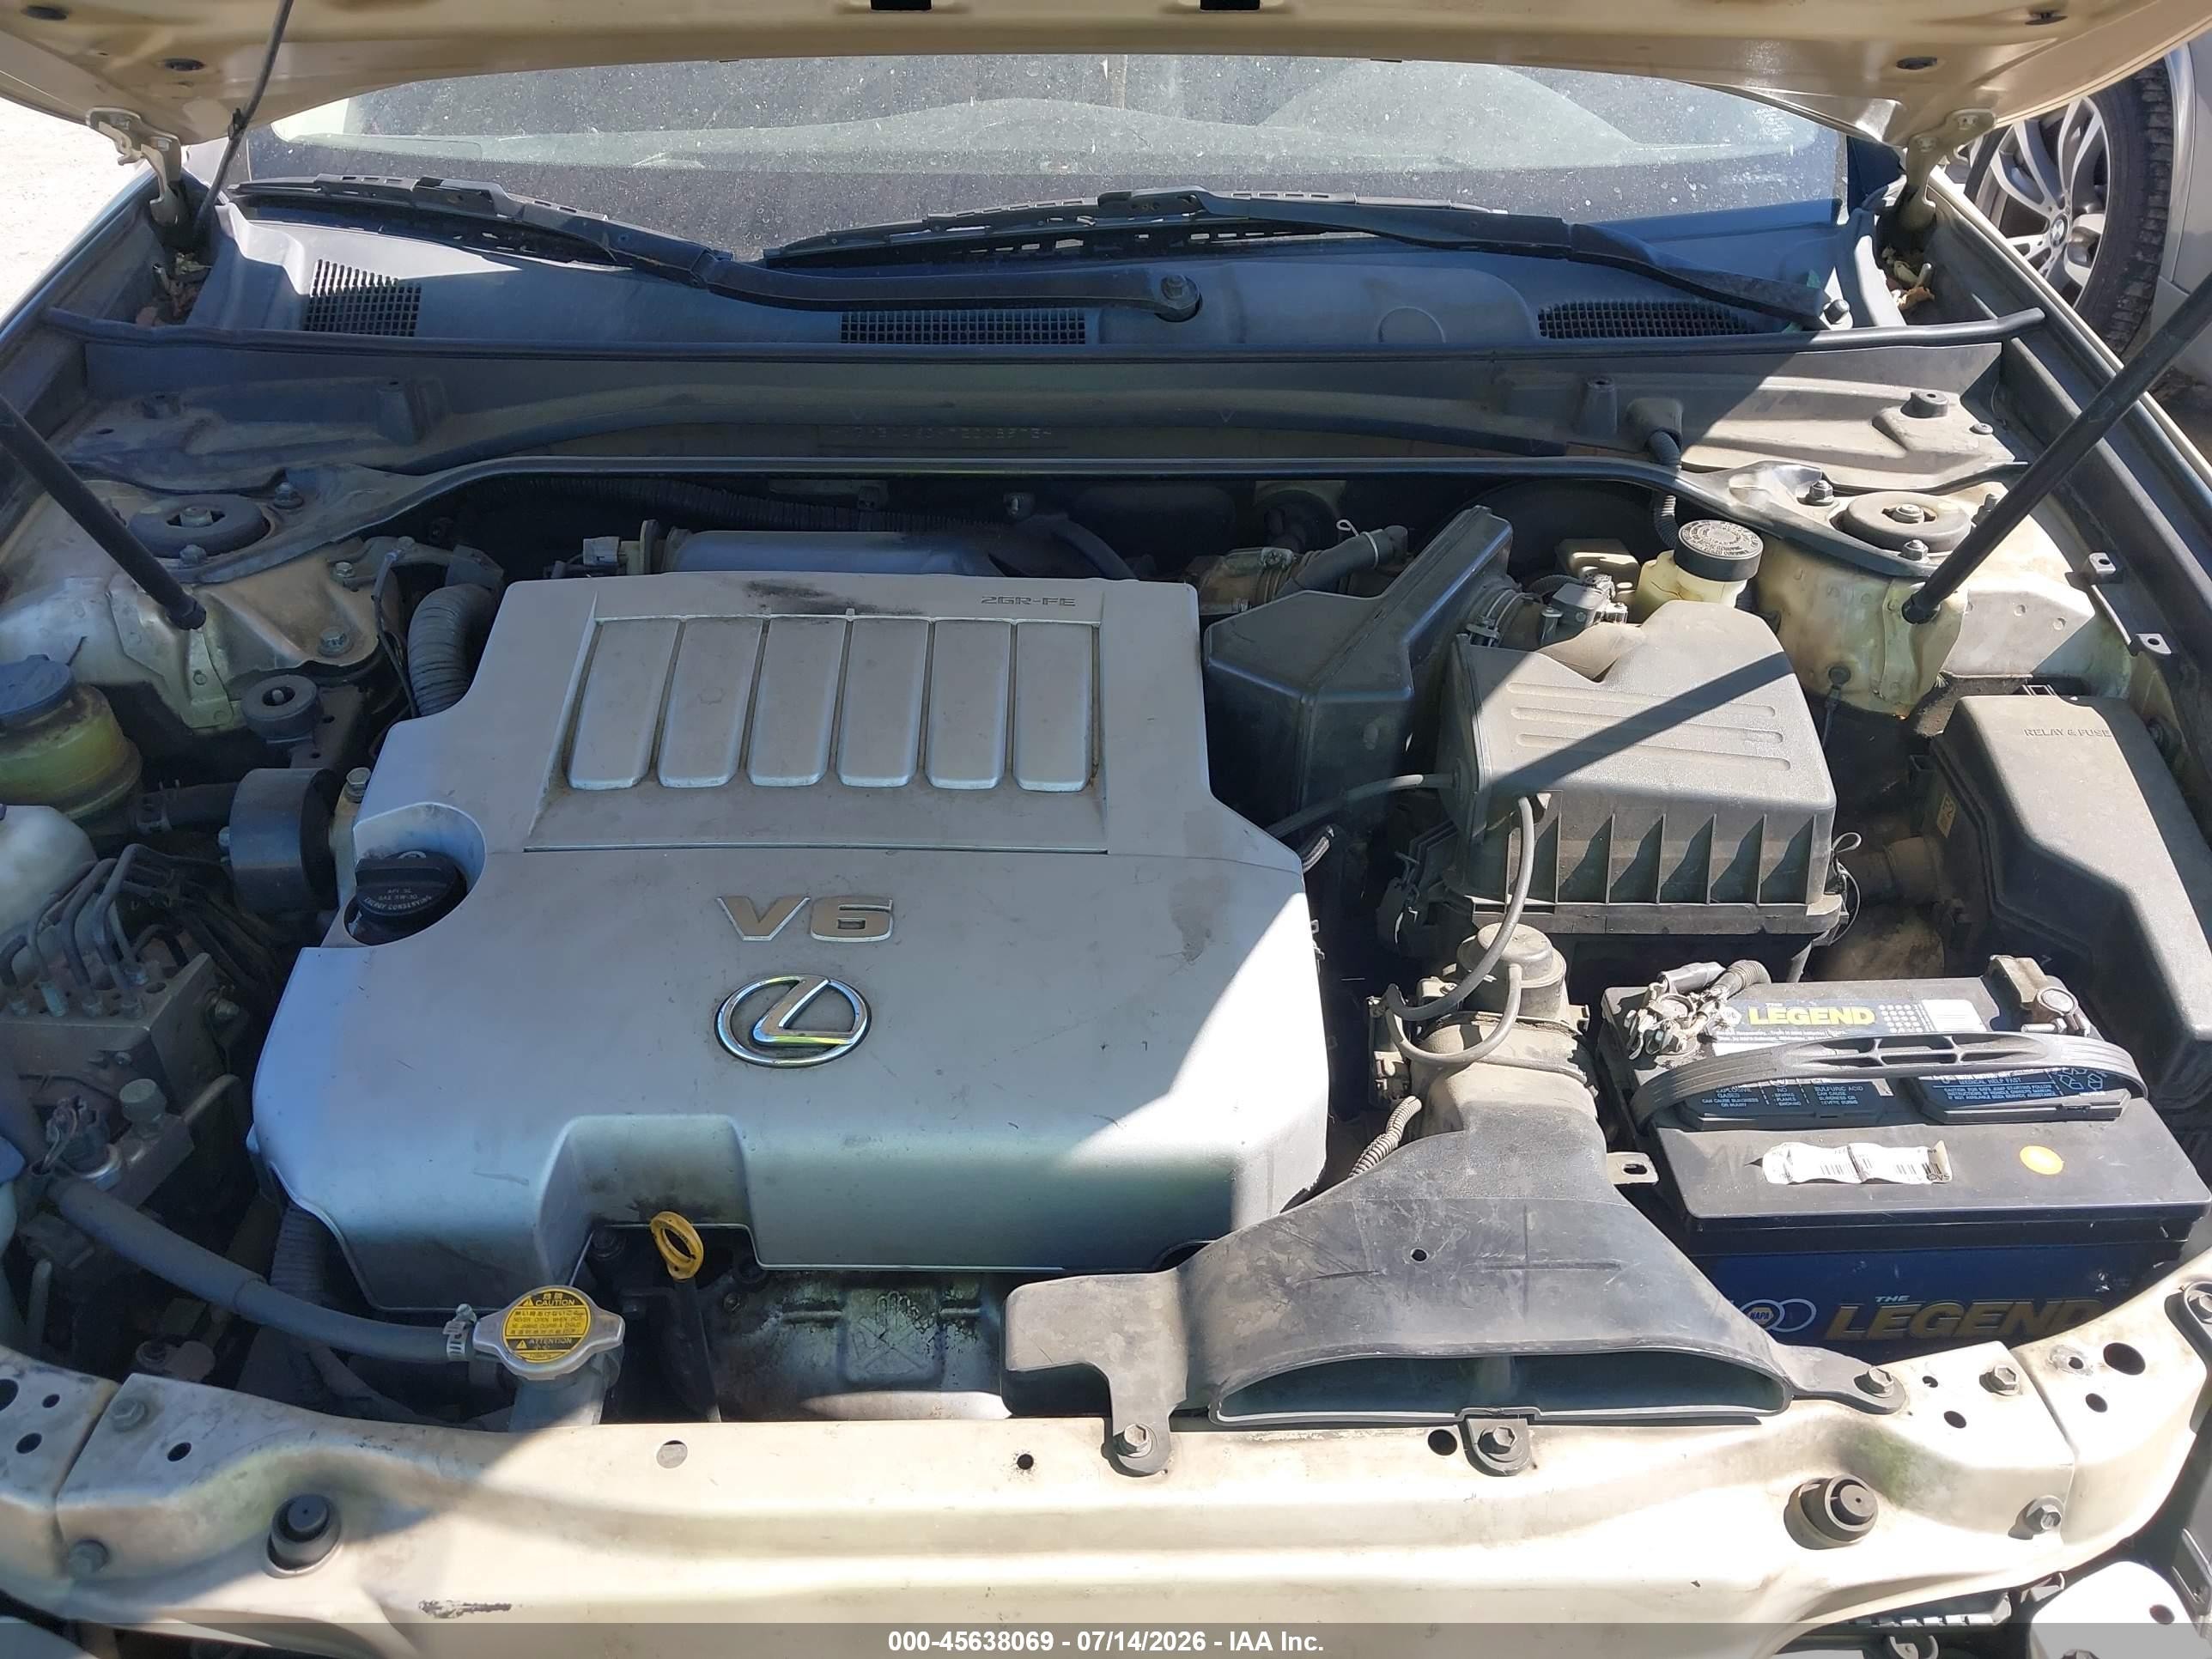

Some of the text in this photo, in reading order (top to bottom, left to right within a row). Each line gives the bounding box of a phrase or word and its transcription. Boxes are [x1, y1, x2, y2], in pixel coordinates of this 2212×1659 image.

[981, 595, 1076, 607] 2GR-FE
[2023, 727, 2112, 738] RELAY & FUSE
[714, 896, 894, 943] V6
[1747, 1006, 1875, 1025] LEGEND
[1749, 1311, 1770, 1321] NAPA
[1824, 1299, 2104, 1341] LEGEND
